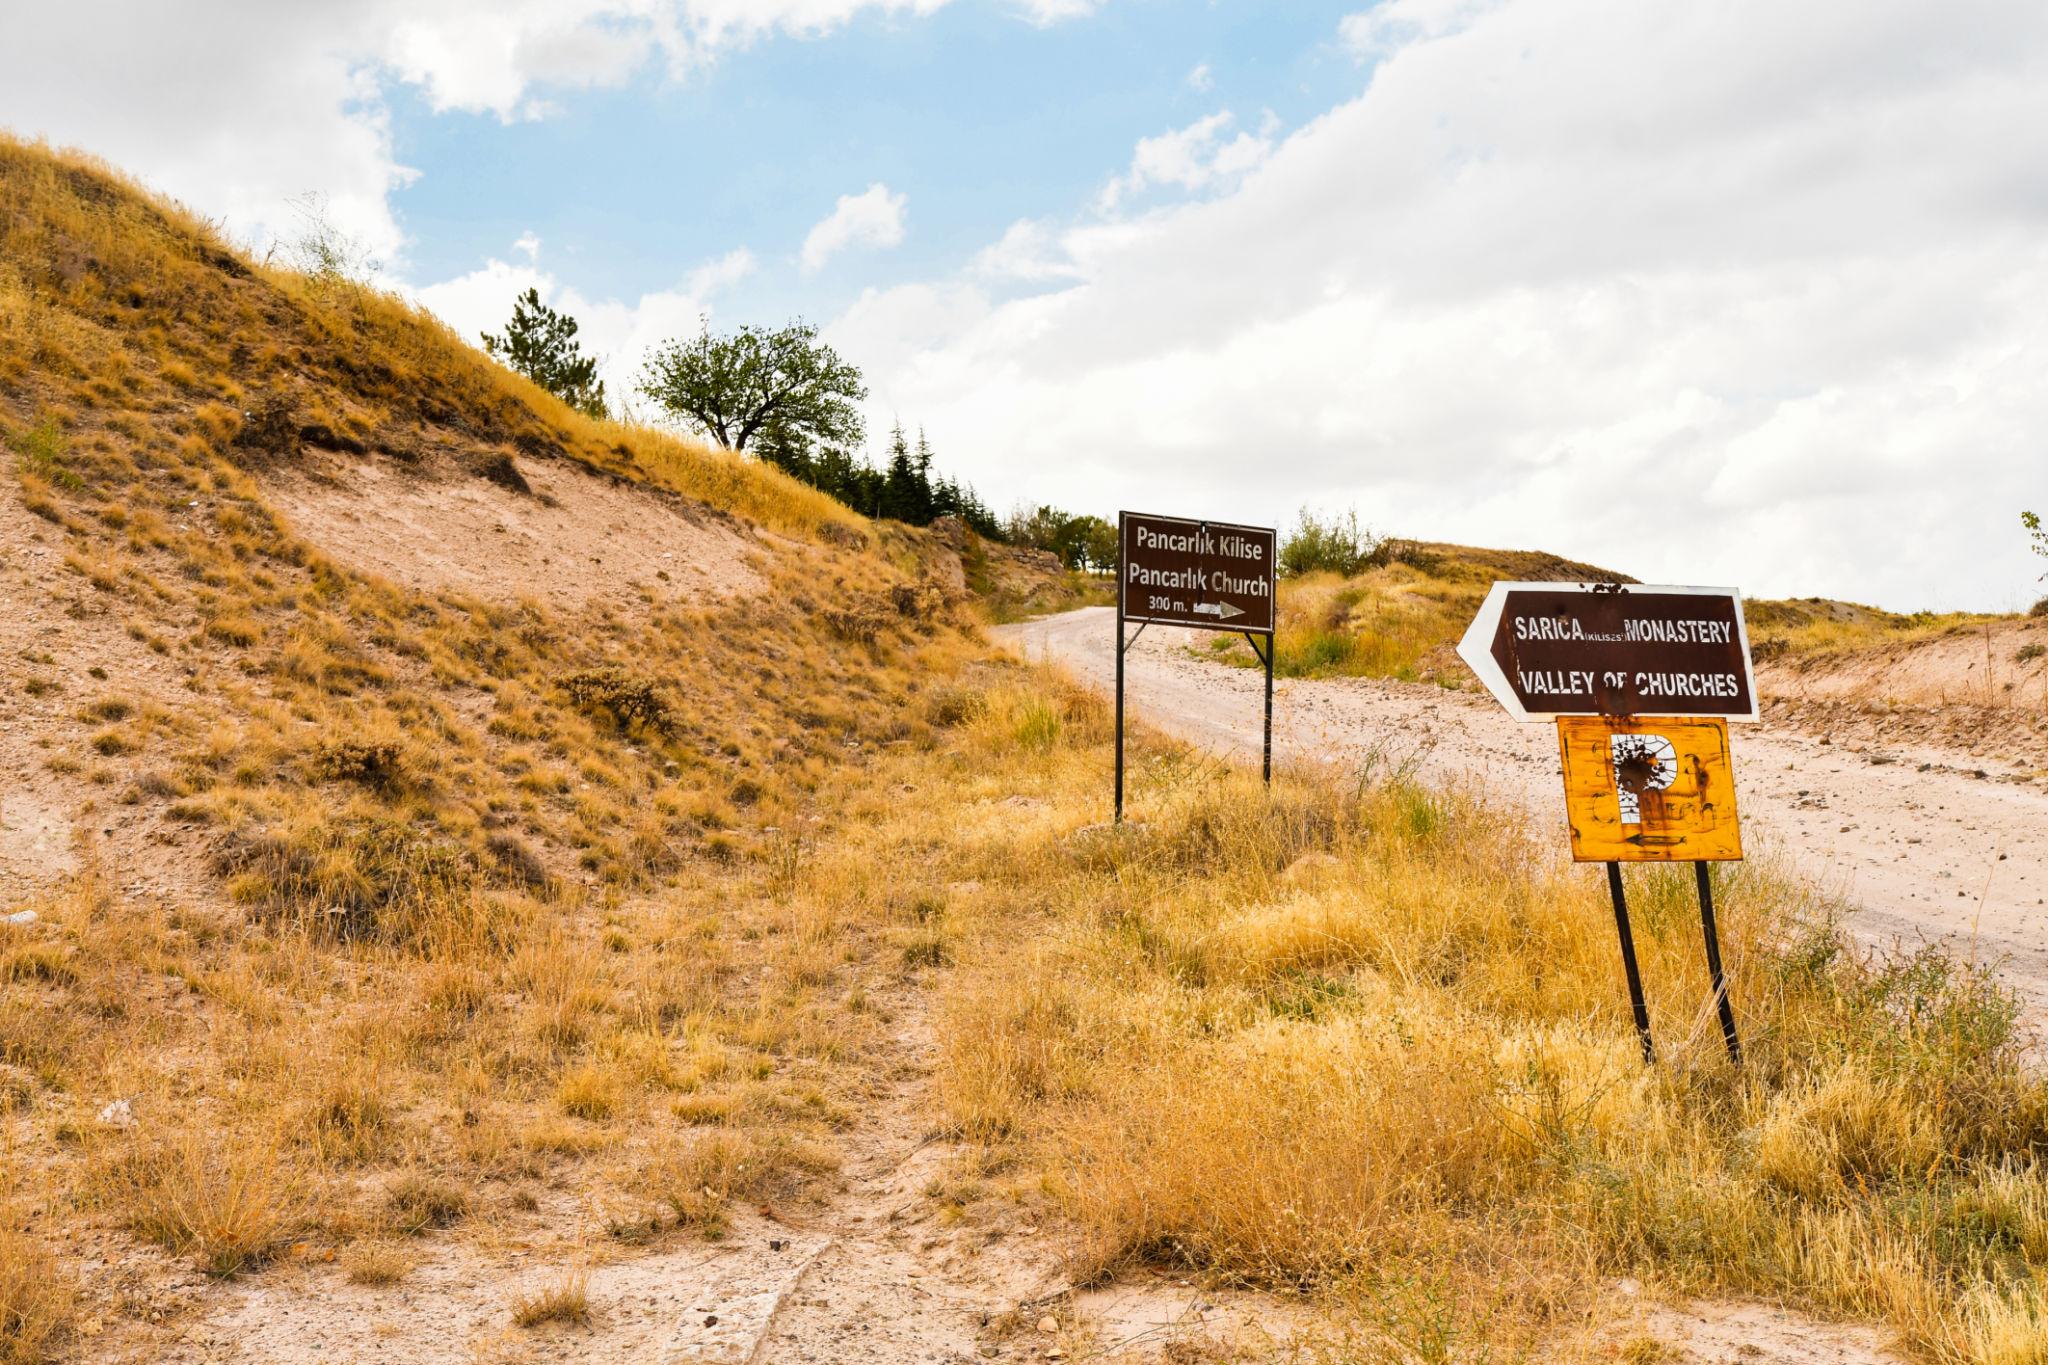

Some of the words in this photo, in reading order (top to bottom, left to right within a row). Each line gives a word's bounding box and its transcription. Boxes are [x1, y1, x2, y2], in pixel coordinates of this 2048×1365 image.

[1219, 535, 1262, 560] Kilise
[1211, 571, 1269, 597] Church
[1149, 595, 1170, 611] 300
[1173, 600, 1188, 612] m.
[1515, 616, 1584, 640] SARICA
[1624, 619, 1731, 643] MONASTERY
[1520, 669, 1595, 694] VALLEY
[1635, 672, 1739, 697] CHURCHES
[1610, 734, 1678, 824] P
